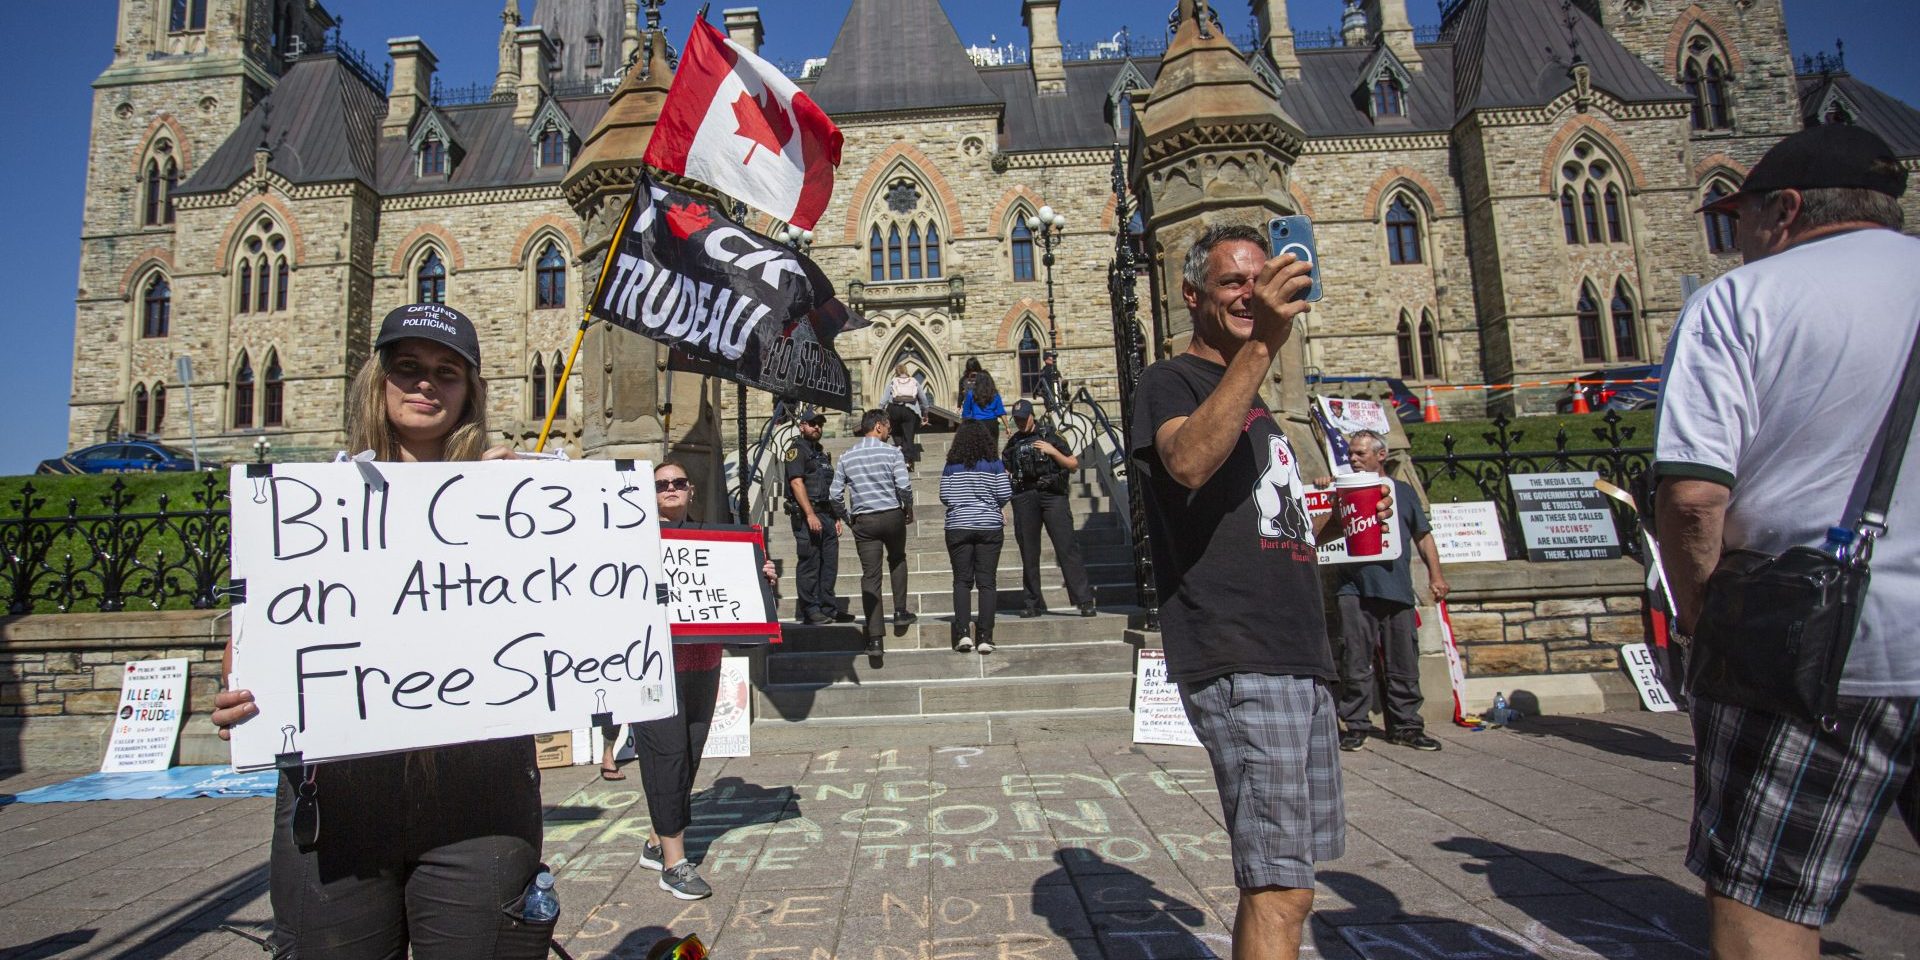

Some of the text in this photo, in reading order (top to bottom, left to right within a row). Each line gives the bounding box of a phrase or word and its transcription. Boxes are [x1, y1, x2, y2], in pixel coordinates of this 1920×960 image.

[407, 305, 457, 320] DEFUND
[604, 252, 771, 361] TRUDEAU
[424, 311, 440, 319] THE
[402, 319, 457, 335] POLITICIANS
[1529, 478, 1584, 487] THE MEDIA LIES,
[1518, 490, 1600, 500] THE GOVERNMENT CAN'T
[1339, 498, 1357, 518] im
[1541, 501, 1586, 510] BE TRUSTED,
[269, 473, 647, 560] Bill C-63 is
[1530, 512, 1604, 522] AND THESE SO CALLED
[1545, 524, 1593, 533] "VACCINES"
[1537, 535, 1608, 545] ARE KILLING PEOPLE!
[663, 546, 710, 567] ARE
[1544, 551, 1569, 560] THERE,
[1574, 550, 1591, 558] SAID
[665, 568, 706, 587] YOU
[267, 556, 649, 627] an Attack on
[689, 588, 728, 603] THE
[297, 624, 664, 733] Free Speech
[127, 688, 173, 701] ILLEGAL
[1001, 769, 1219, 796] EYE
[666, 896, 831, 934] ARE
[882, 892, 1050, 929] NOT
